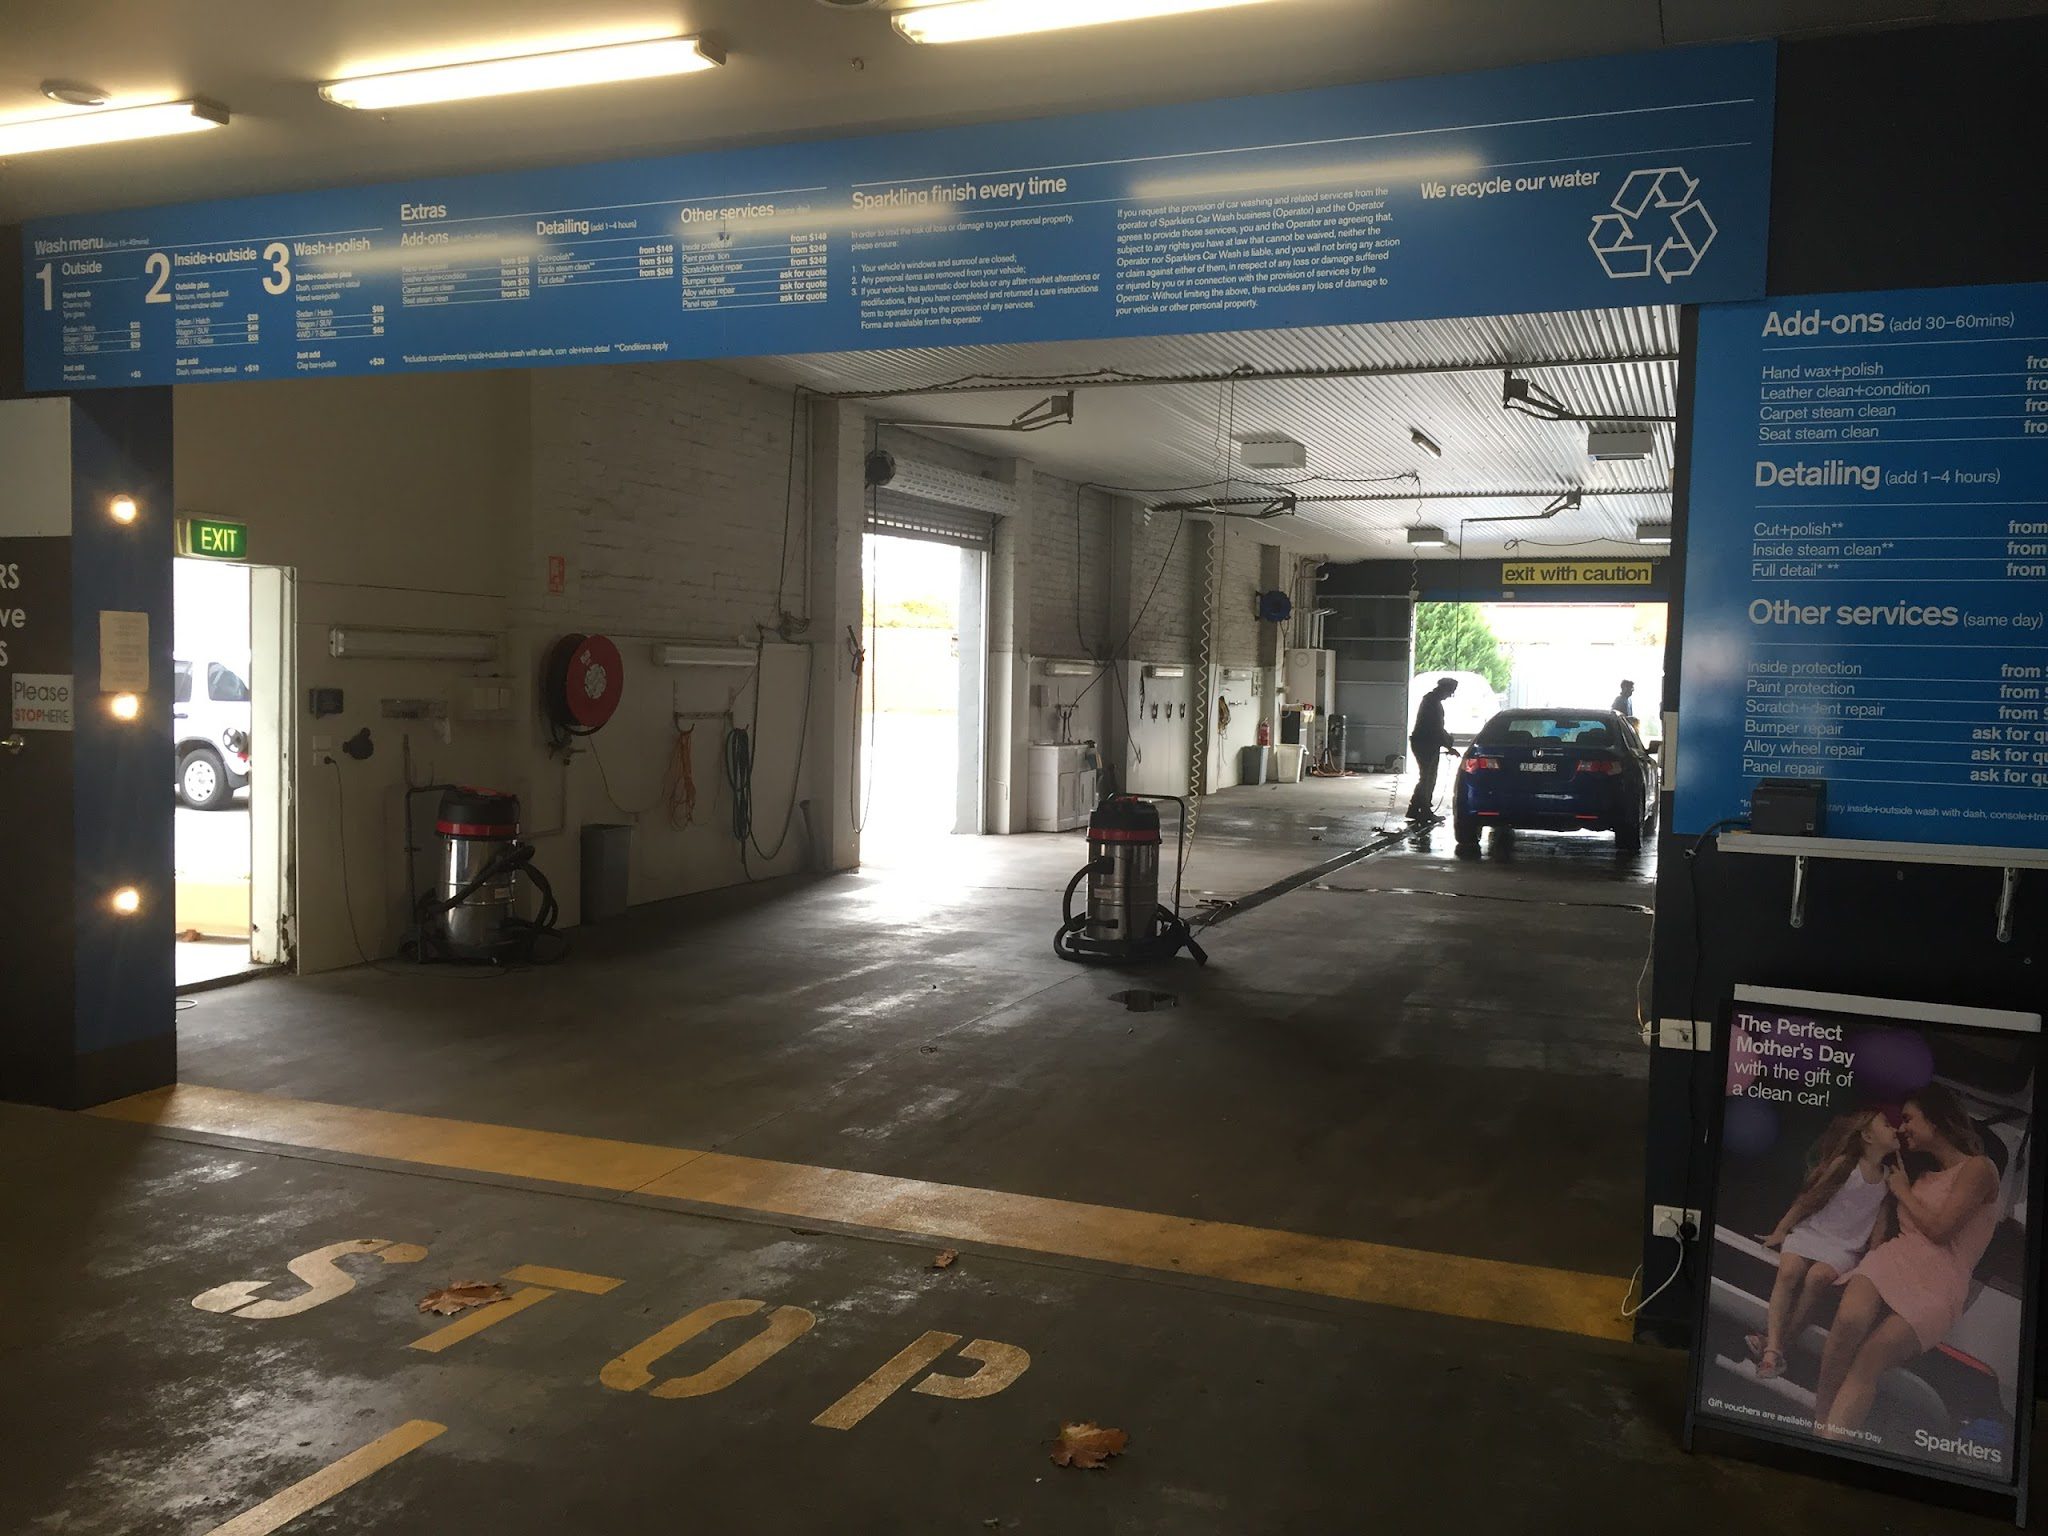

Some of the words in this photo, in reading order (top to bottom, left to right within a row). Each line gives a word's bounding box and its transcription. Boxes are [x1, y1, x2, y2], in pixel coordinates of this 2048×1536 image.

[1420, 181, 1447, 199] We
[1450, 176, 1512, 197] recycle
[1515, 176, 1546, 191] our
[1549, 169, 1600, 188] water
[852, 188, 930, 211] Sparkling
[931, 182, 976, 202] finish
[979, 181, 1025, 199] every
[1027, 176, 1067, 195] time
[400, 203, 447, 221] Extras
[681, 208, 719, 224] Other
[719, 203, 775, 221] services
[34, 237, 68, 255] Wash
[69, 237, 104, 251] menu
[293, 237, 372, 258] Wash+polish
[401, 231, 449, 247] Add-ons
[174, 246, 257, 266] Inside+outside
[61, 260, 102, 275] Outside
[262, 242, 291, 295] 3
[35, 262, 52, 311] 1
[145, 252, 172, 303] 2
[780, 295, 794, 303] ask
[794, 294, 806, 302] for
[806, 292, 828, 303] quote
[1761, 309, 1885, 337] Add-ons
[1889, 316, 1922, 333] (add
[1925, 311, 2015, 330] 30–60mins)
[1762, 364, 1800, 379] Hand
[1803, 361, 1884, 379] wax+polish
[1761, 385, 1813, 400] Leather
[1816, 380, 1930, 398] clean+condition
[1759, 406, 1809, 422] Carpet
[1811, 406, 1854, 419] steam
[1857, 403, 1896, 417] clean
[1758, 426, 1791, 440] Seat
[1794, 427, 1837, 440] steam
[1841, 424, 1879, 438] clean
[1755, 460, 1880, 490] Detailing
[1885, 470, 1918, 486] (add
[1954, 467, 2001, 484] hours)
[2007, 519, 2048, 534] from
[201, 526, 237, 552] EXIT
[2006, 540, 2047, 555] from
[1752, 542, 1794, 556] Inside
[1797, 543, 1840, 556] steam
[1504, 566, 1536, 581] exit
[1540, 565, 1577, 581] with
[1582, 565, 1649, 581] caution
[2006, 562, 2046, 576] from
[1748, 598, 1831, 625] Other
[1836, 601, 1959, 626] services
[1963, 611, 2008, 627] (same
[2012, 611, 2044, 629] day)
[1745, 658, 1788, 674] Inside
[1791, 661, 1862, 676] protection
[2000, 663, 2041, 678] from
[14, 681, 69, 702] Please
[1746, 679, 1781, 693] Paint
[1784, 680, 1855, 696] protection
[1999, 684, 2040, 699] from
[1745, 699, 1841, 717] Scratch+dent
[1845, 702, 1886, 718] repair
[1998, 705, 2038, 720] from
[1744, 719, 1800, 735] Bumper
[1801, 720, 1844, 737] repair
[1972, 726, 2002, 740] ask
[2005, 727, 2030, 741] for
[1743, 739, 1777, 755] Alloy
[1779, 740, 1821, 755] wheel
[1824, 743, 1865, 757] repair
[1970, 747, 2001, 761] ask
[2004, 747, 2029, 762] for
[1743, 758, 1781, 773] Panel
[1784, 761, 1825, 776] repair
[1969, 768, 1999, 782] ask
[2003, 768, 2028, 783] for
[1736, 1013, 1772, 1034] The
[1776, 1018, 1843, 1041] Perfect
[1735, 1034, 1813, 1060] Mother's
[1818, 1044, 1855, 1067] Day
[1734, 1058, 1768, 1077] with
[1772, 1062, 1800, 1080] the
[1804, 1066, 1831, 1085] gift
[1835, 1070, 1854, 1087] of
[1731, 1081, 1745, 1096] a
[1743, 1081, 1792, 1102] clean
[1797, 1090, 1830, 1107] car!
[192, 1238, 1031, 1430] STOP
[1914, 1428, 2002, 1463] Sparklers
